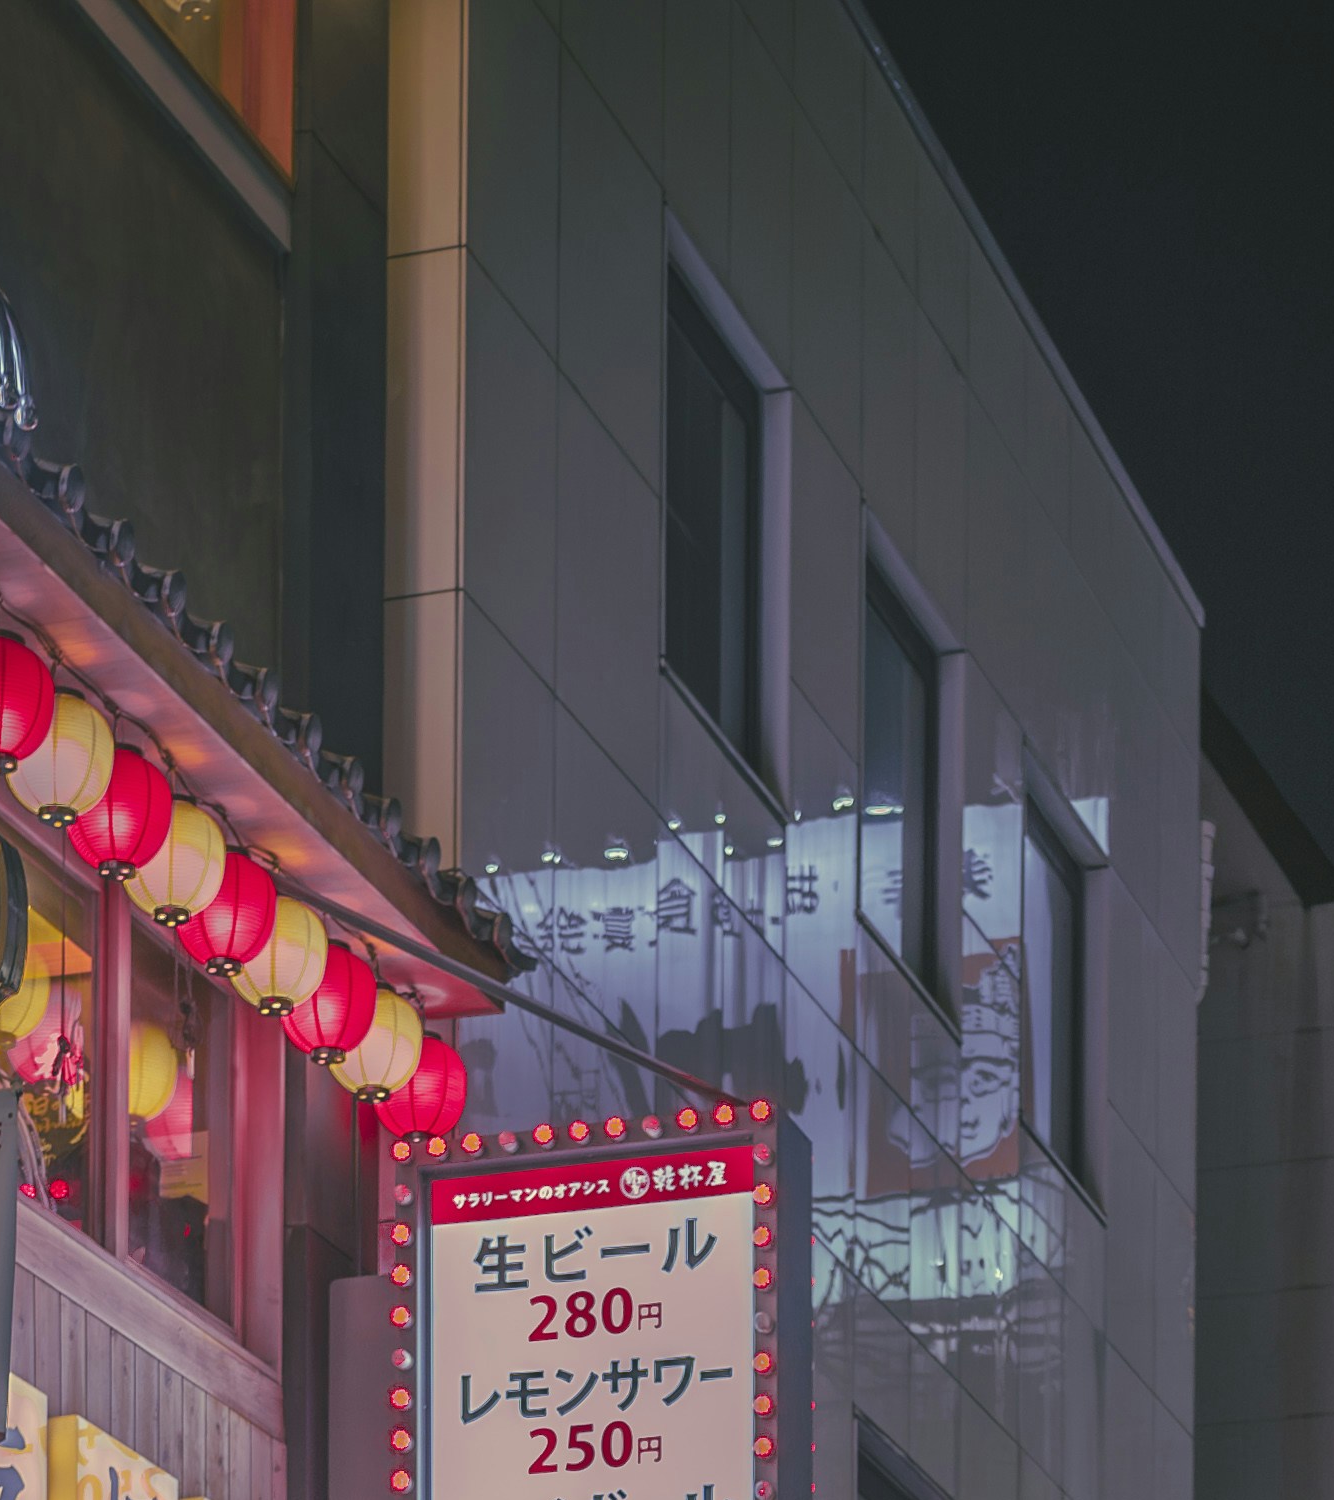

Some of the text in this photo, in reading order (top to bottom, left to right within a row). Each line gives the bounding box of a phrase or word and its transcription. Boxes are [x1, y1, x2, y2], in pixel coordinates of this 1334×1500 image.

[452, 1179, 611, 1210] サラリーマンのオアシス
[653, 1160, 728, 1192] 乾杯屋
[473, 1217, 717, 1294] 生ビール
[528, 1286, 664, 1343] 280円
[461, 1354, 734, 1425] レモンサワー
[528, 1420, 664, 1476] 250円
